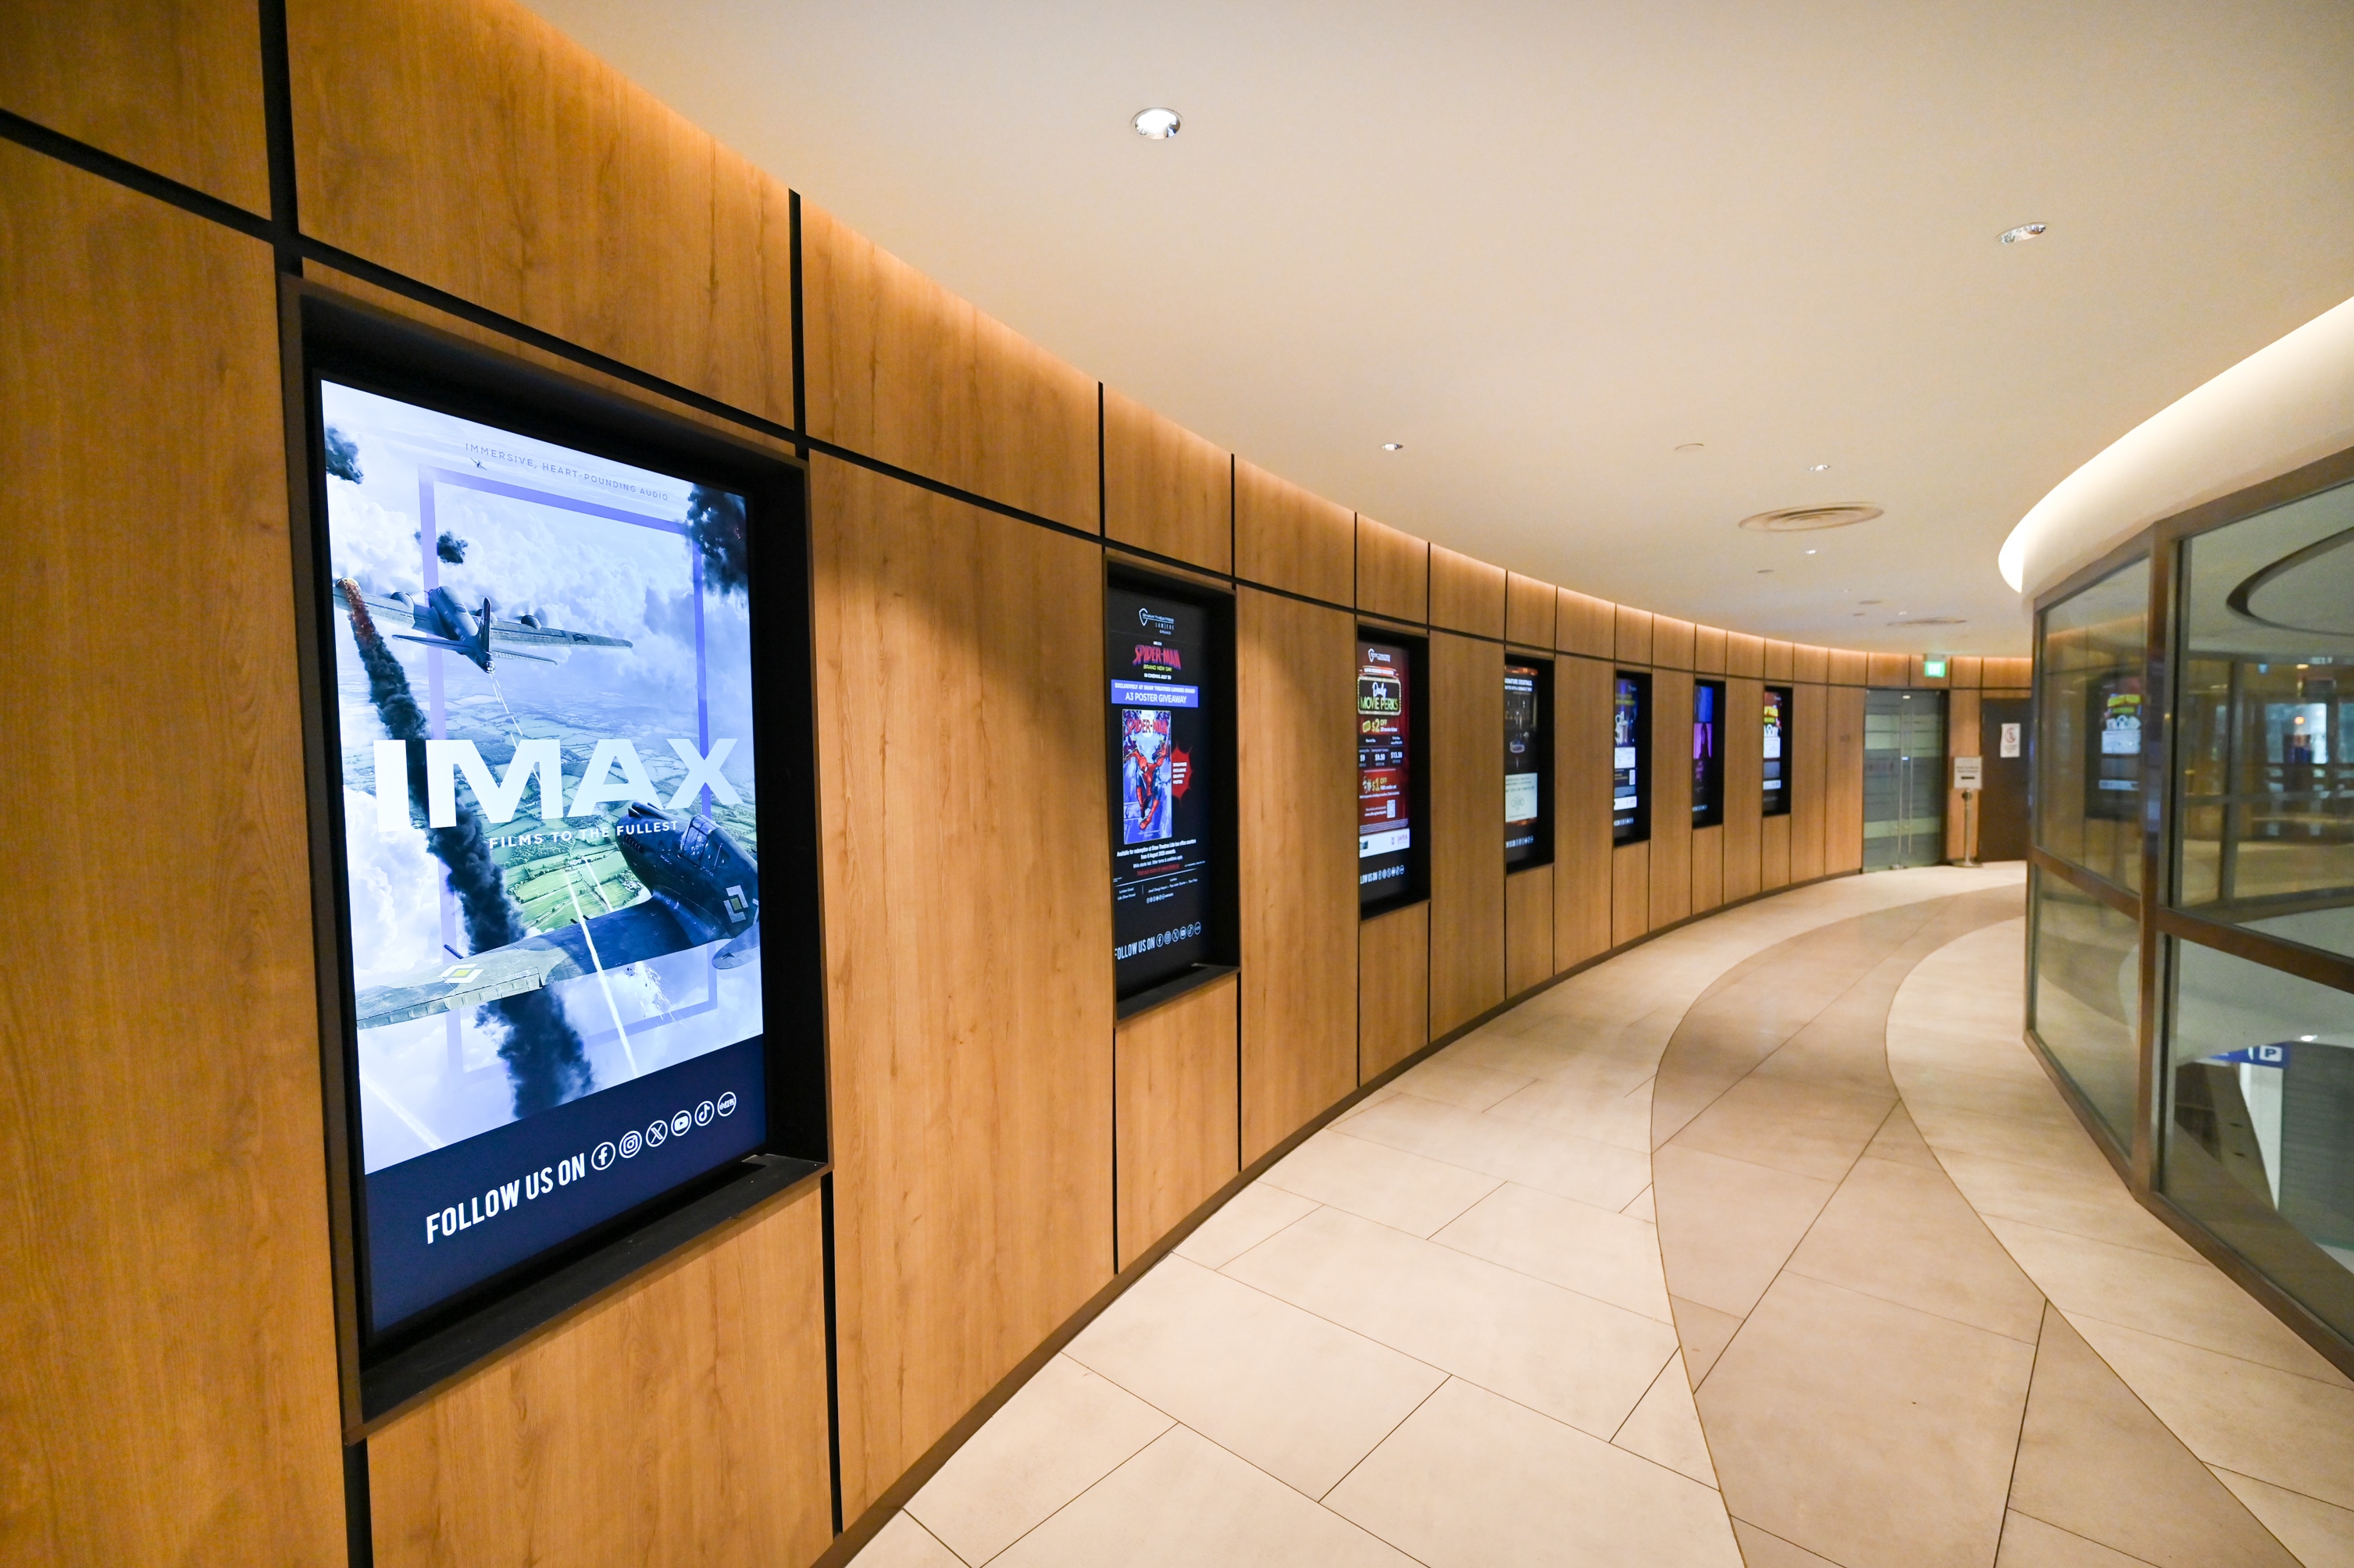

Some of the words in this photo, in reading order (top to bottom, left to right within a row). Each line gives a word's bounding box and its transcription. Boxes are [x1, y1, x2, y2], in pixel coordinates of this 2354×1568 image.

[465, 443, 538, 469] IMMERSIVE,
[542, 462, 636, 493] HEART-POUNDING
[640, 487, 668, 501] AUDIO
[1132, 644, 1181, 670] SPIDER-MAN
[1125, 692, 1133, 700] A3
[1135, 692, 1157, 702] POSTER
[1158, 694, 1187, 704] GIVEAWAY
[1360, 697, 1379, 710] MOVIE
[1380, 697, 1398, 711] PERKS
[1123, 718, 1168, 738] SPIDER-MAN
[1371, 718, 1380, 732] $2
[373, 738, 744, 832] IMAX
[489, 835, 544, 850] FILMS
[551, 830, 572, 843] TO
[581, 825, 610, 839] THE
[617, 821, 679, 836] FULLEST
[1138, 939, 1147, 953] US
[1147, 936, 1155, 950] ON
[426, 1179, 520, 1245] FOLLOW
[525, 1167, 554, 1199] US
[558, 1153, 586, 1186] ON
